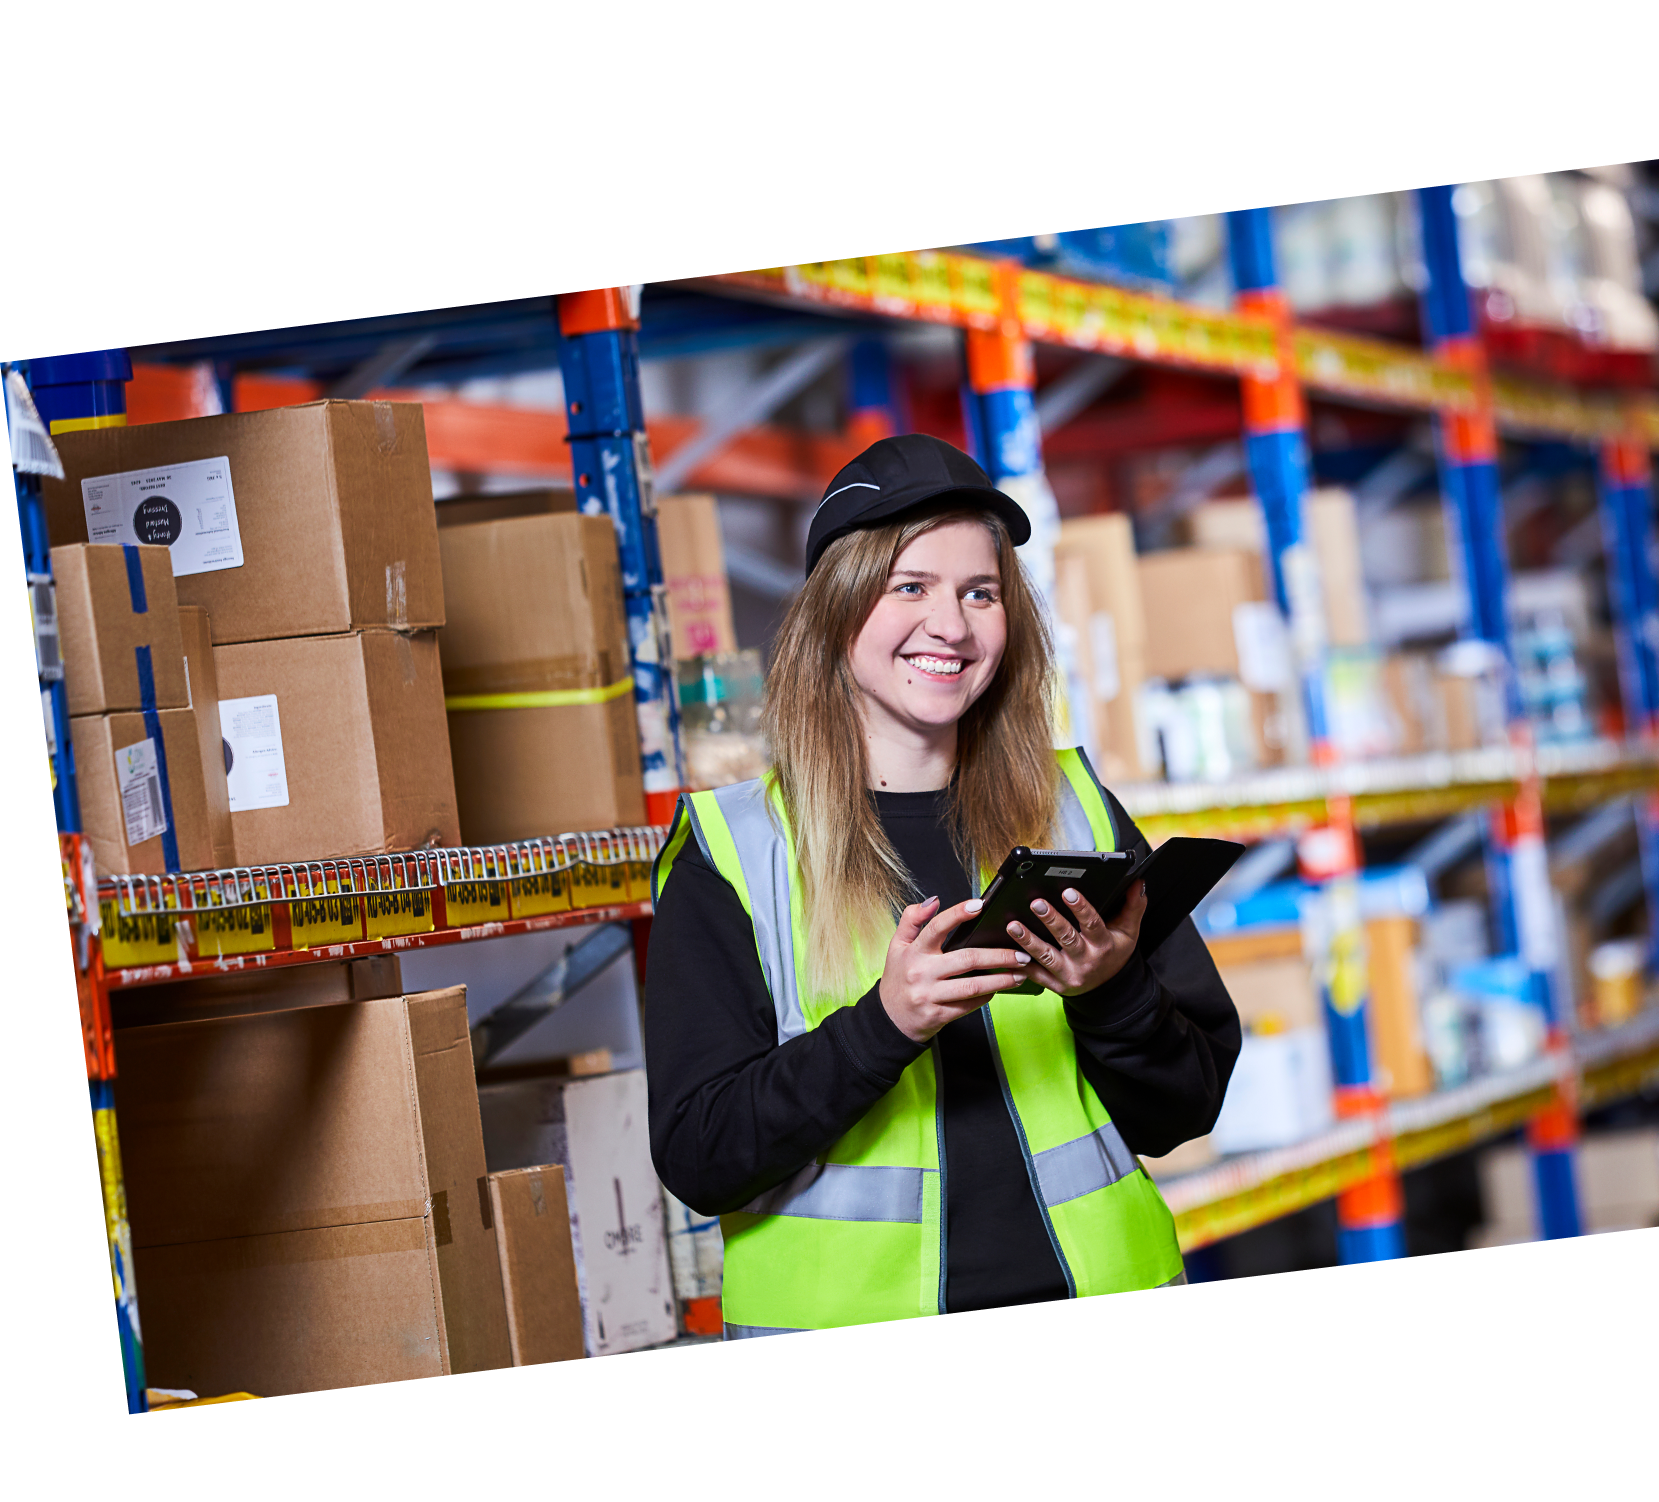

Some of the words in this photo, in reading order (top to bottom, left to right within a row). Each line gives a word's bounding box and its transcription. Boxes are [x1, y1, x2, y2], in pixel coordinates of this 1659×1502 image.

[142, 504, 168, 515] Dressing
[145, 518, 169, 529] Mustard
[152, 529, 170, 539] Honey
